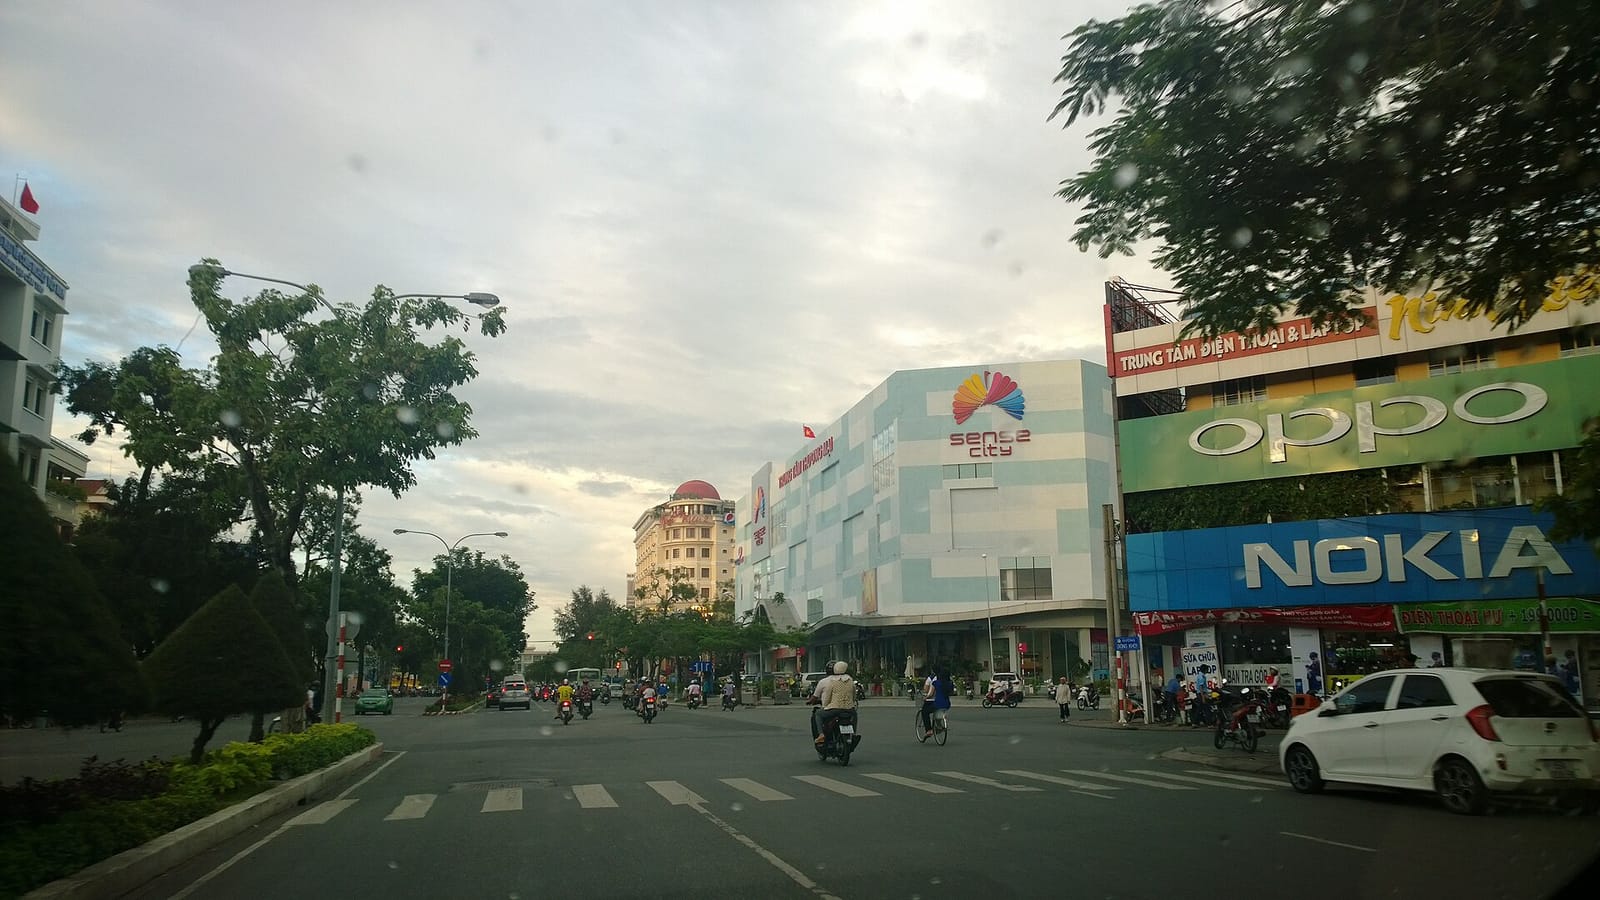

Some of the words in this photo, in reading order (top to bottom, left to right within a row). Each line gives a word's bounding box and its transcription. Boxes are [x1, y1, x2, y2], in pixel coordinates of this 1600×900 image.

[1120, 350, 1163, 371] TRUNG
[1287, 326, 1299, 342] &
[950, 429, 1031, 446] sense
[969, 443, 1012, 457] city
[1243, 525, 1573, 589] NOKIA
[1187, 664, 1217, 676] LAPOP
